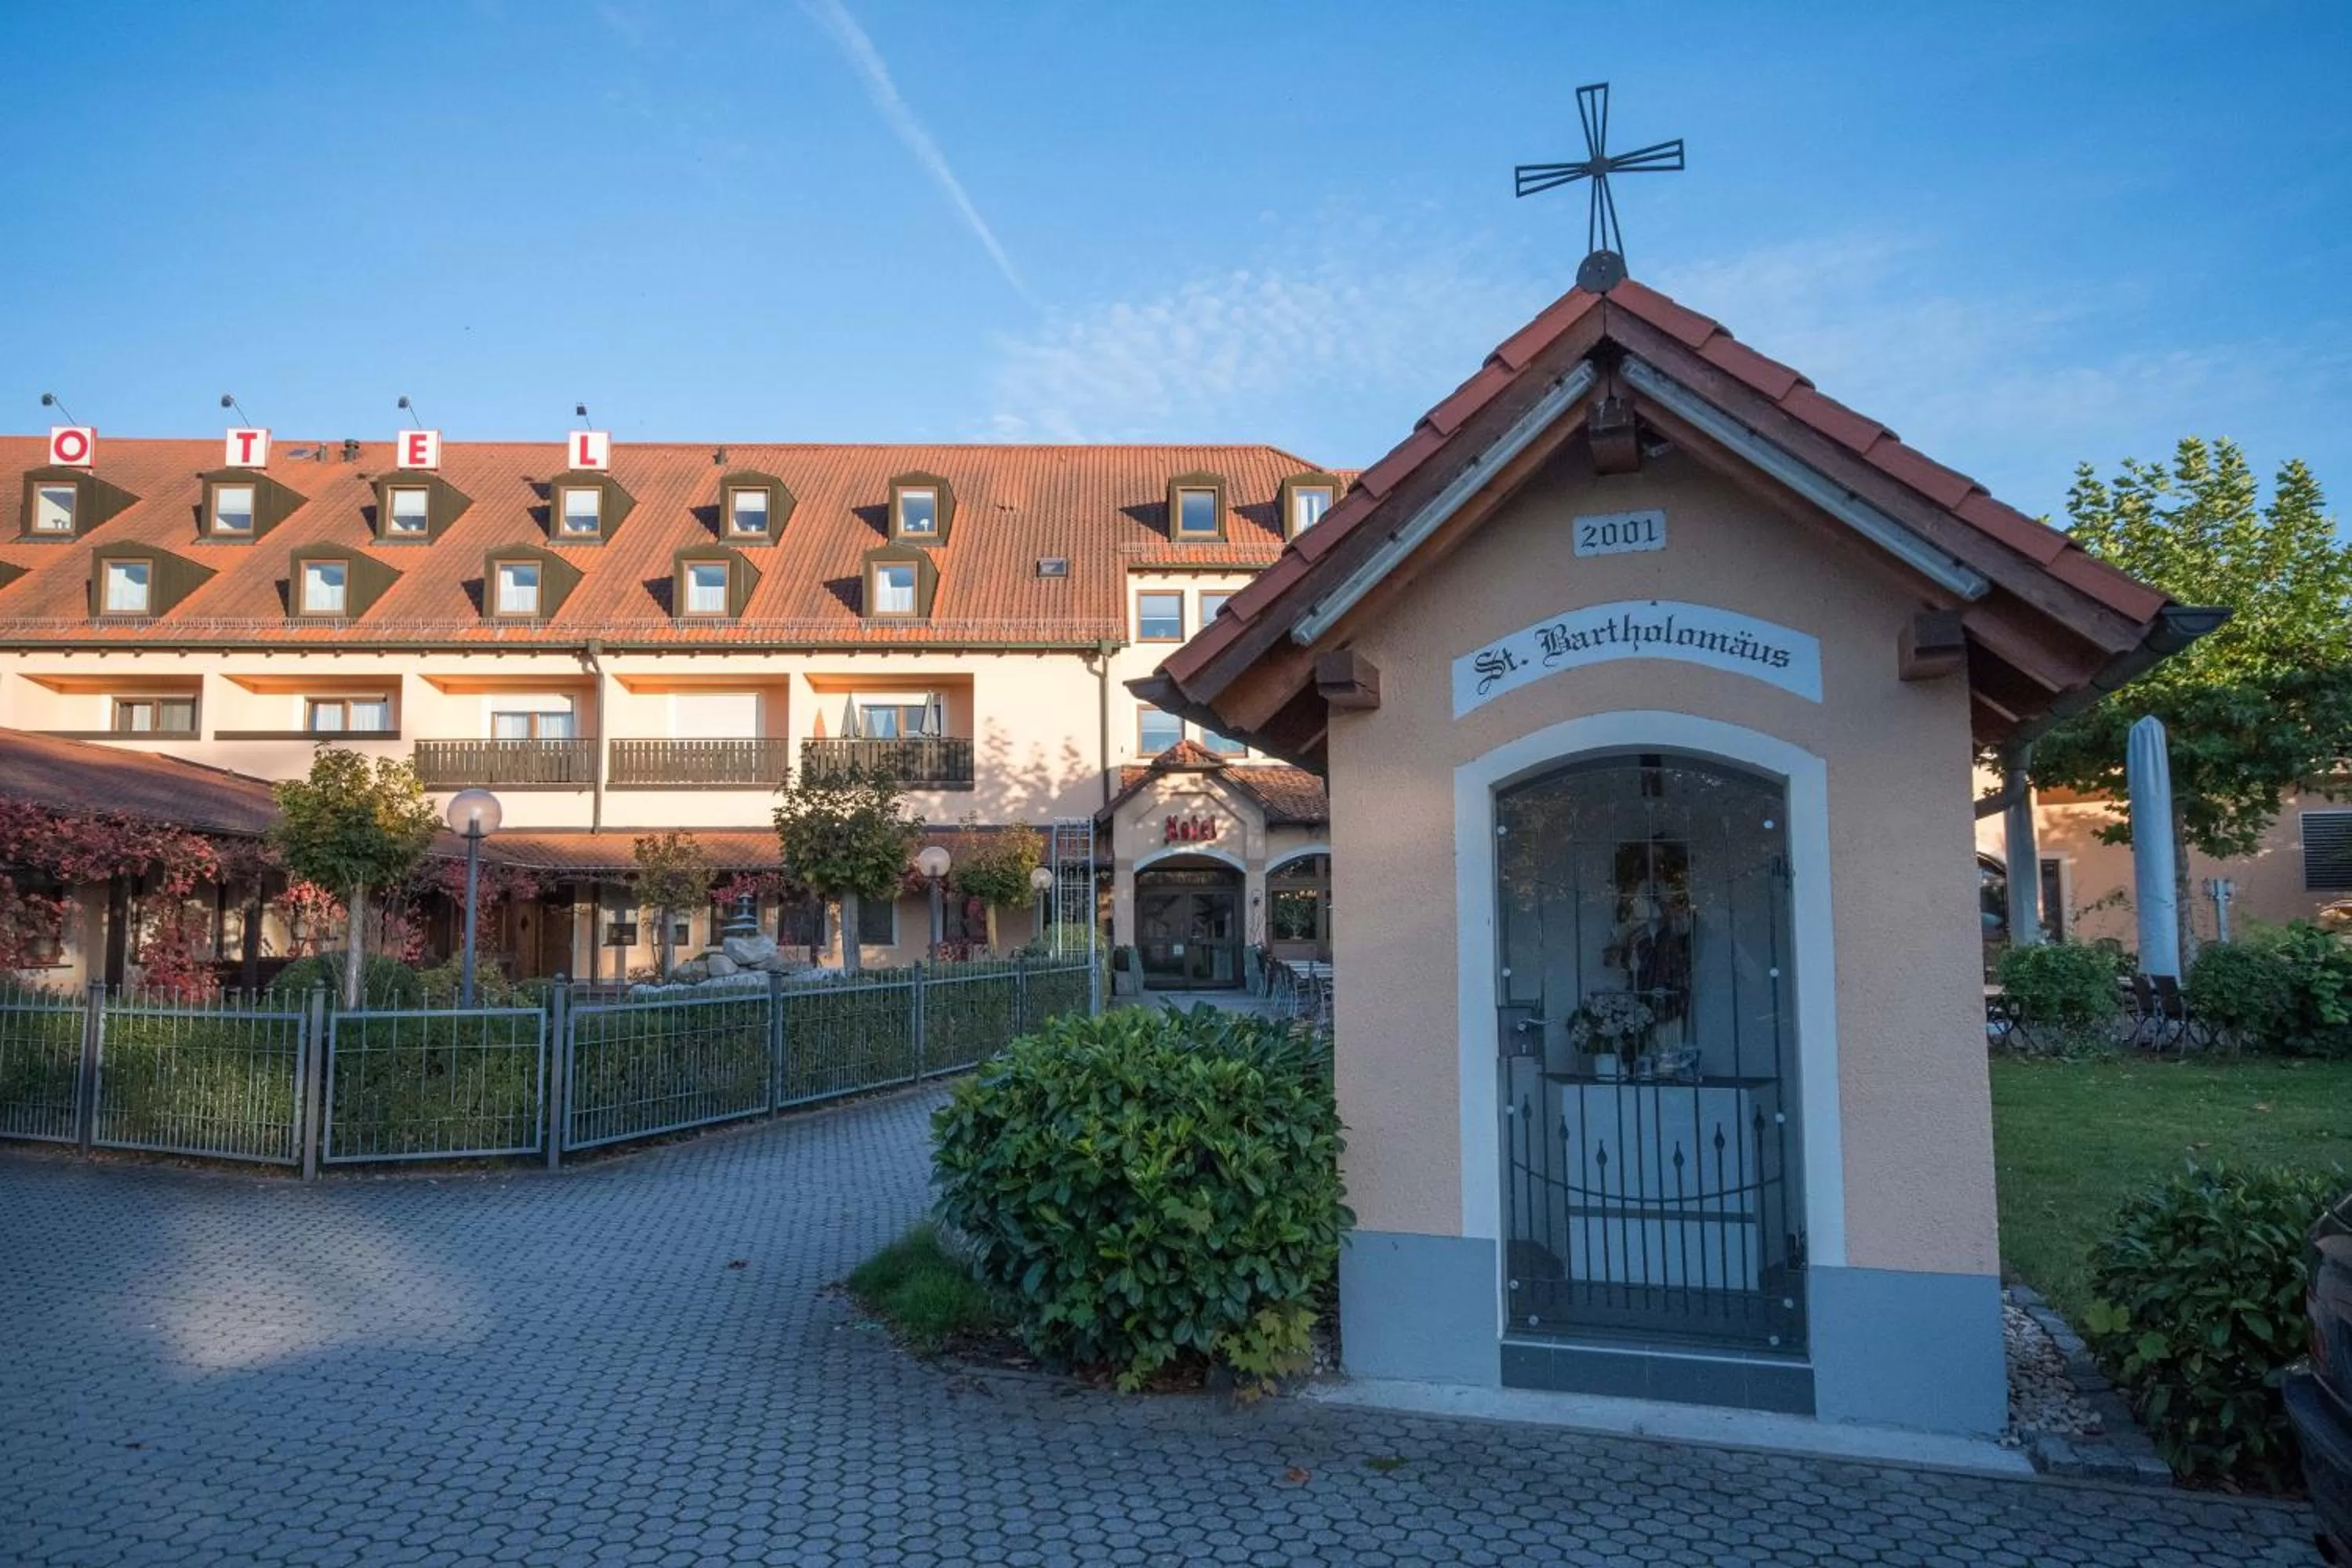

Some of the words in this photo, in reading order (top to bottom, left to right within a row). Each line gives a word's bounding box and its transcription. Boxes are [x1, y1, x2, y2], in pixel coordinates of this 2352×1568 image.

[1580, 518, 1659, 549] 2001
[1474, 647, 1529, 695] St.
[1534, 614, 1791, 669] Bartholomäus
